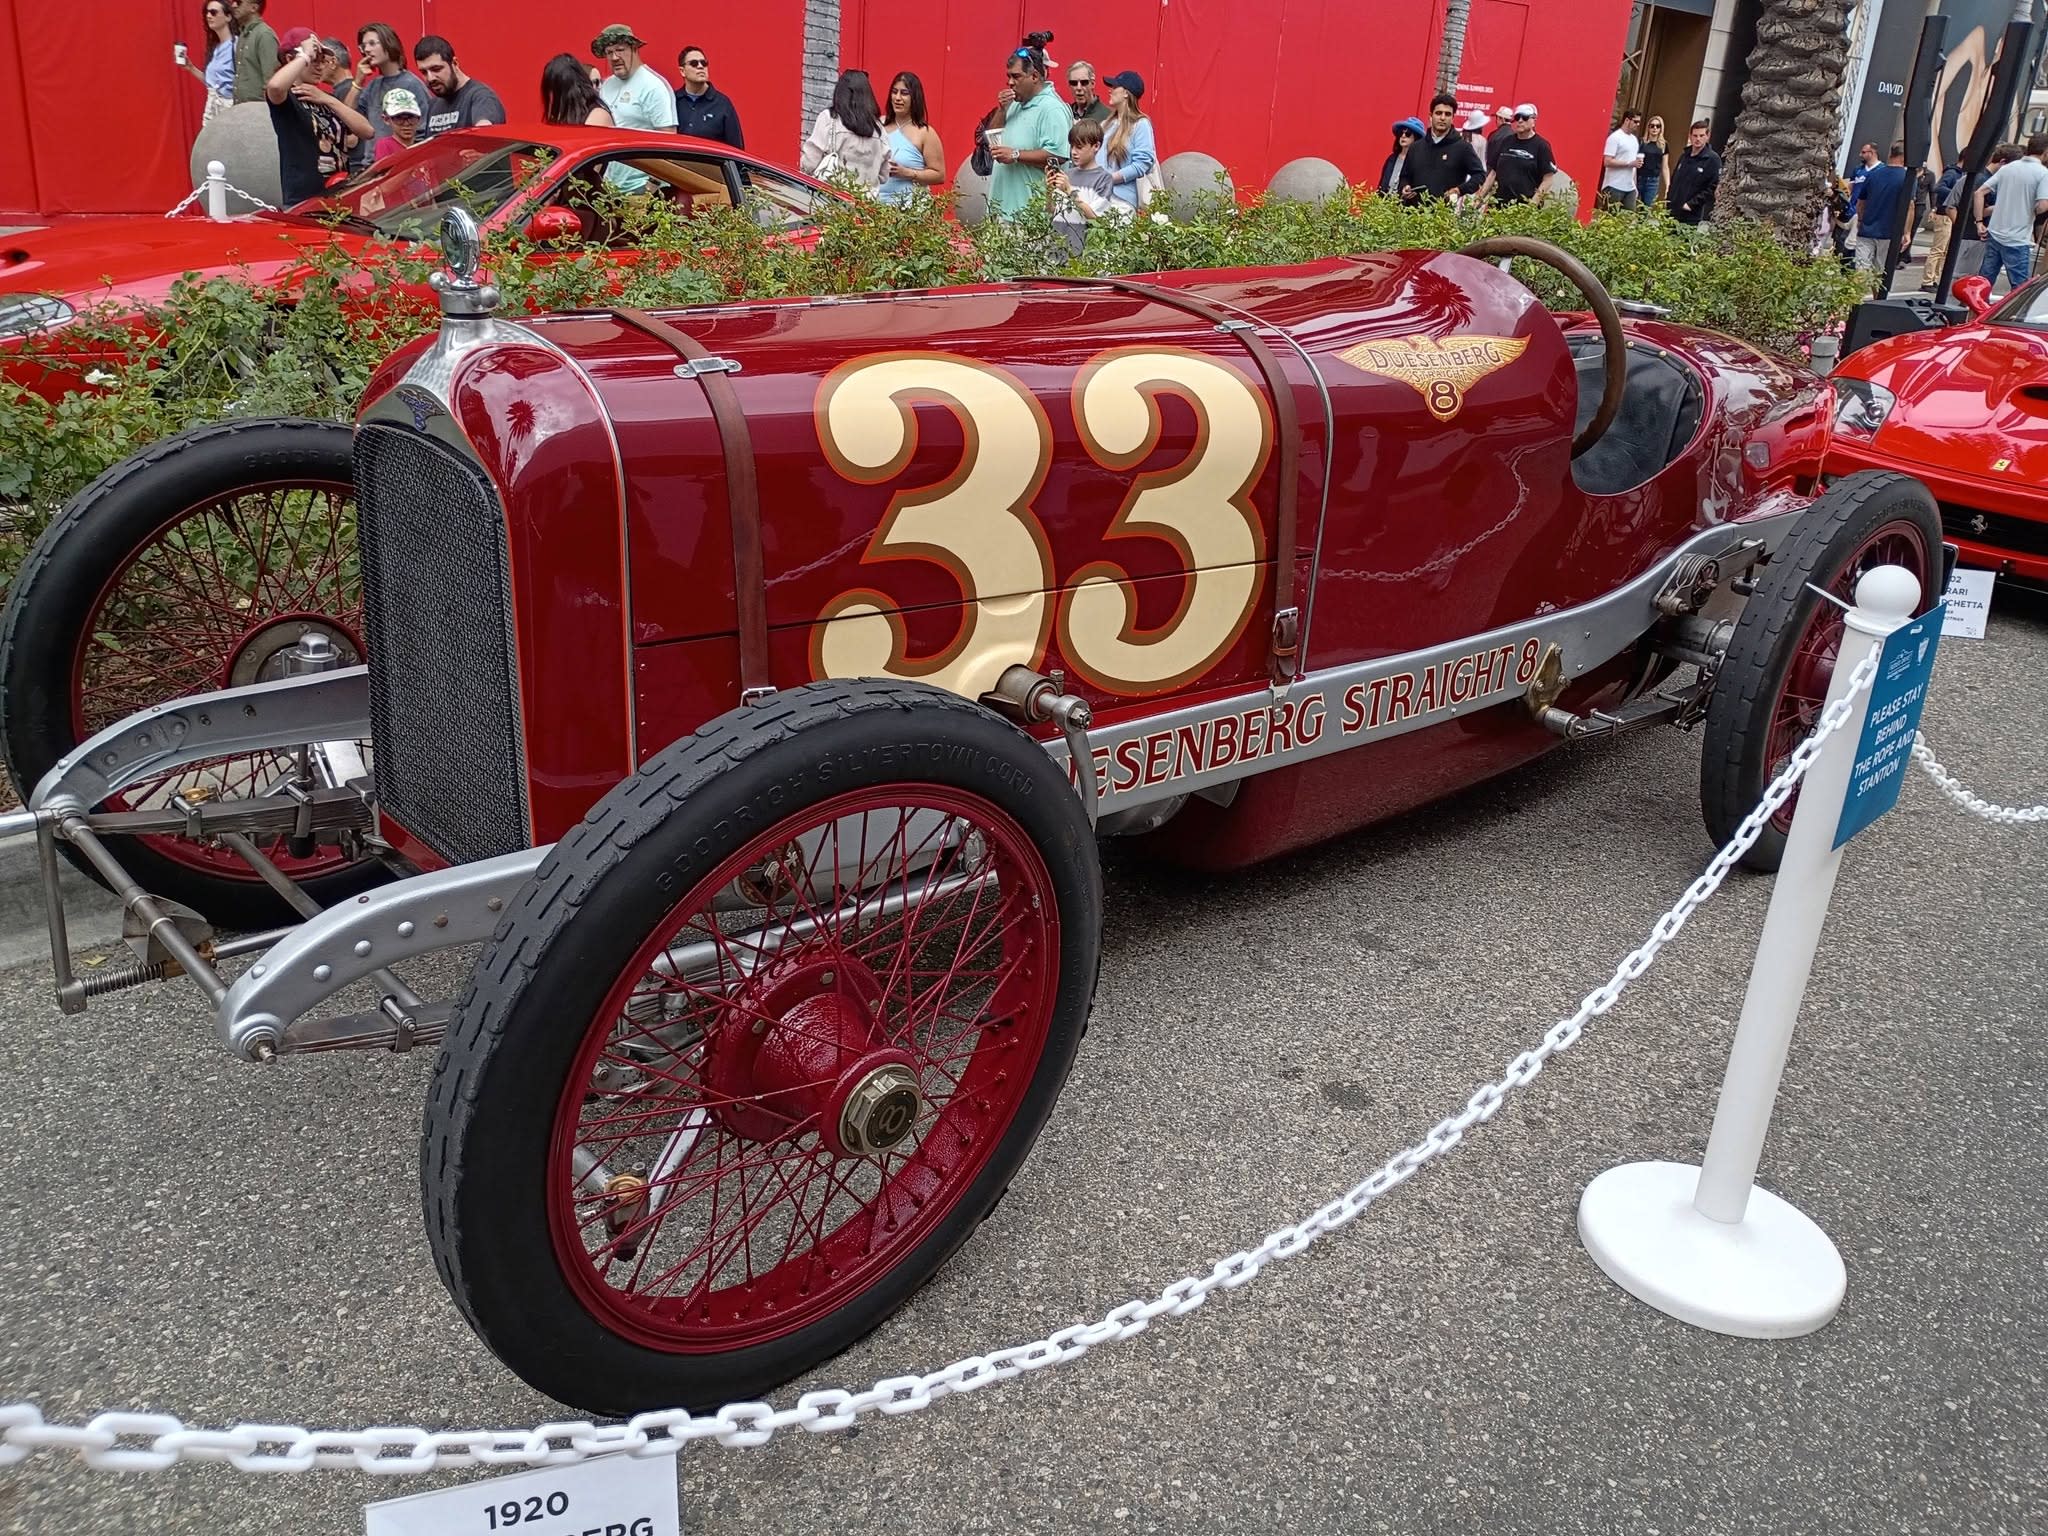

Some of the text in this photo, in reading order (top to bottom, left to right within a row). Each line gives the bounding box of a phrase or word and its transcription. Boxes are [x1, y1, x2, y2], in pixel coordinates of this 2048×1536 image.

[1878, 81, 1904, 96] DAVID
[1368, 341, 1502, 369] DUESENBERG
[1413, 369, 1468, 383] STRAIGHT
[1429, 379, 1460, 416] 8
[808, 345, 1274, 703] 33
[1945, 587, 1969, 596] RARI
[1065, 637, 1541, 799] ESENBERG STRAIGHT 8
[1870, 682, 1924, 728] PLEASE STAY
[1875, 713, 1907, 746] BEHIND
[1854, 728, 1915, 779] THE ROPE AND
[1857, 755, 1901, 797] STANTION
[484, 1491, 569, 1530] 1920
